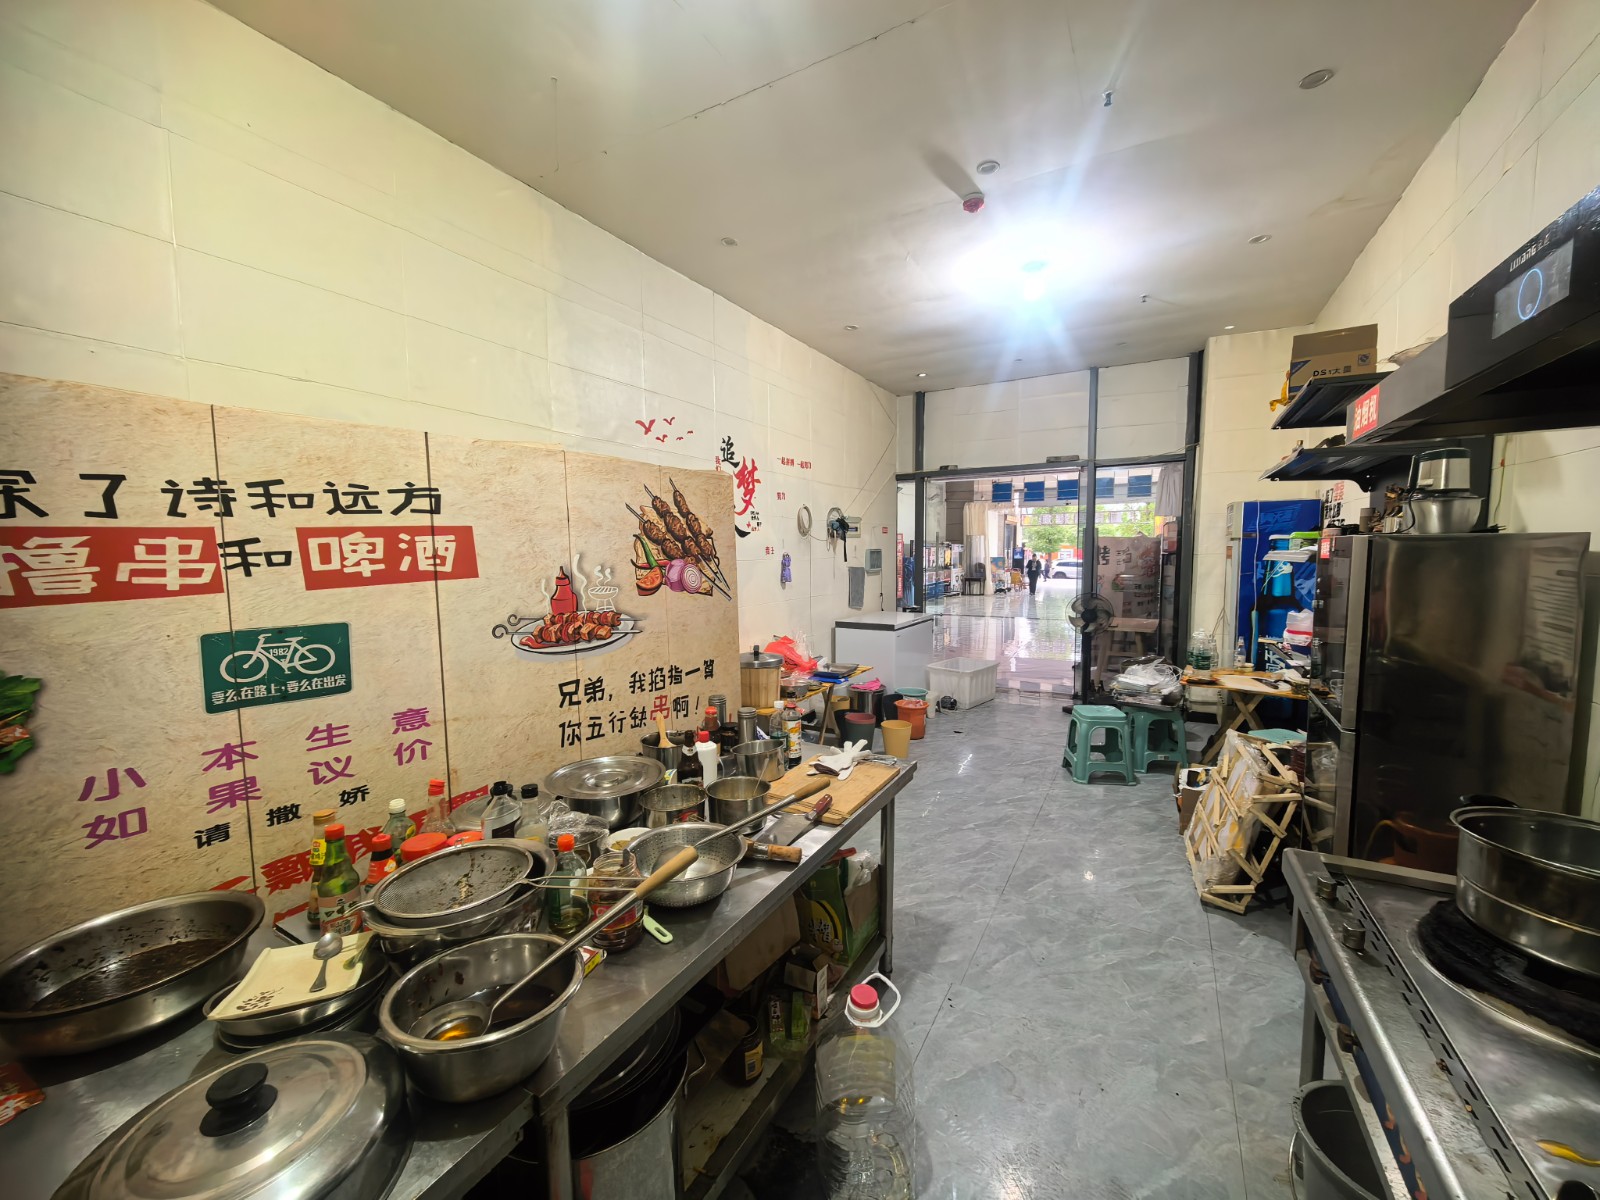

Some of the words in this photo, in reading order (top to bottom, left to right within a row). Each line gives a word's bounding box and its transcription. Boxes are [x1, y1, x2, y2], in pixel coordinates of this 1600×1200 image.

[268, 648, 290, 657] 1982
[77, 706, 431, 802] 小本生意
[81, 737, 433, 850] 如果议价
[193, 784, 371, 850] 请撒娇
